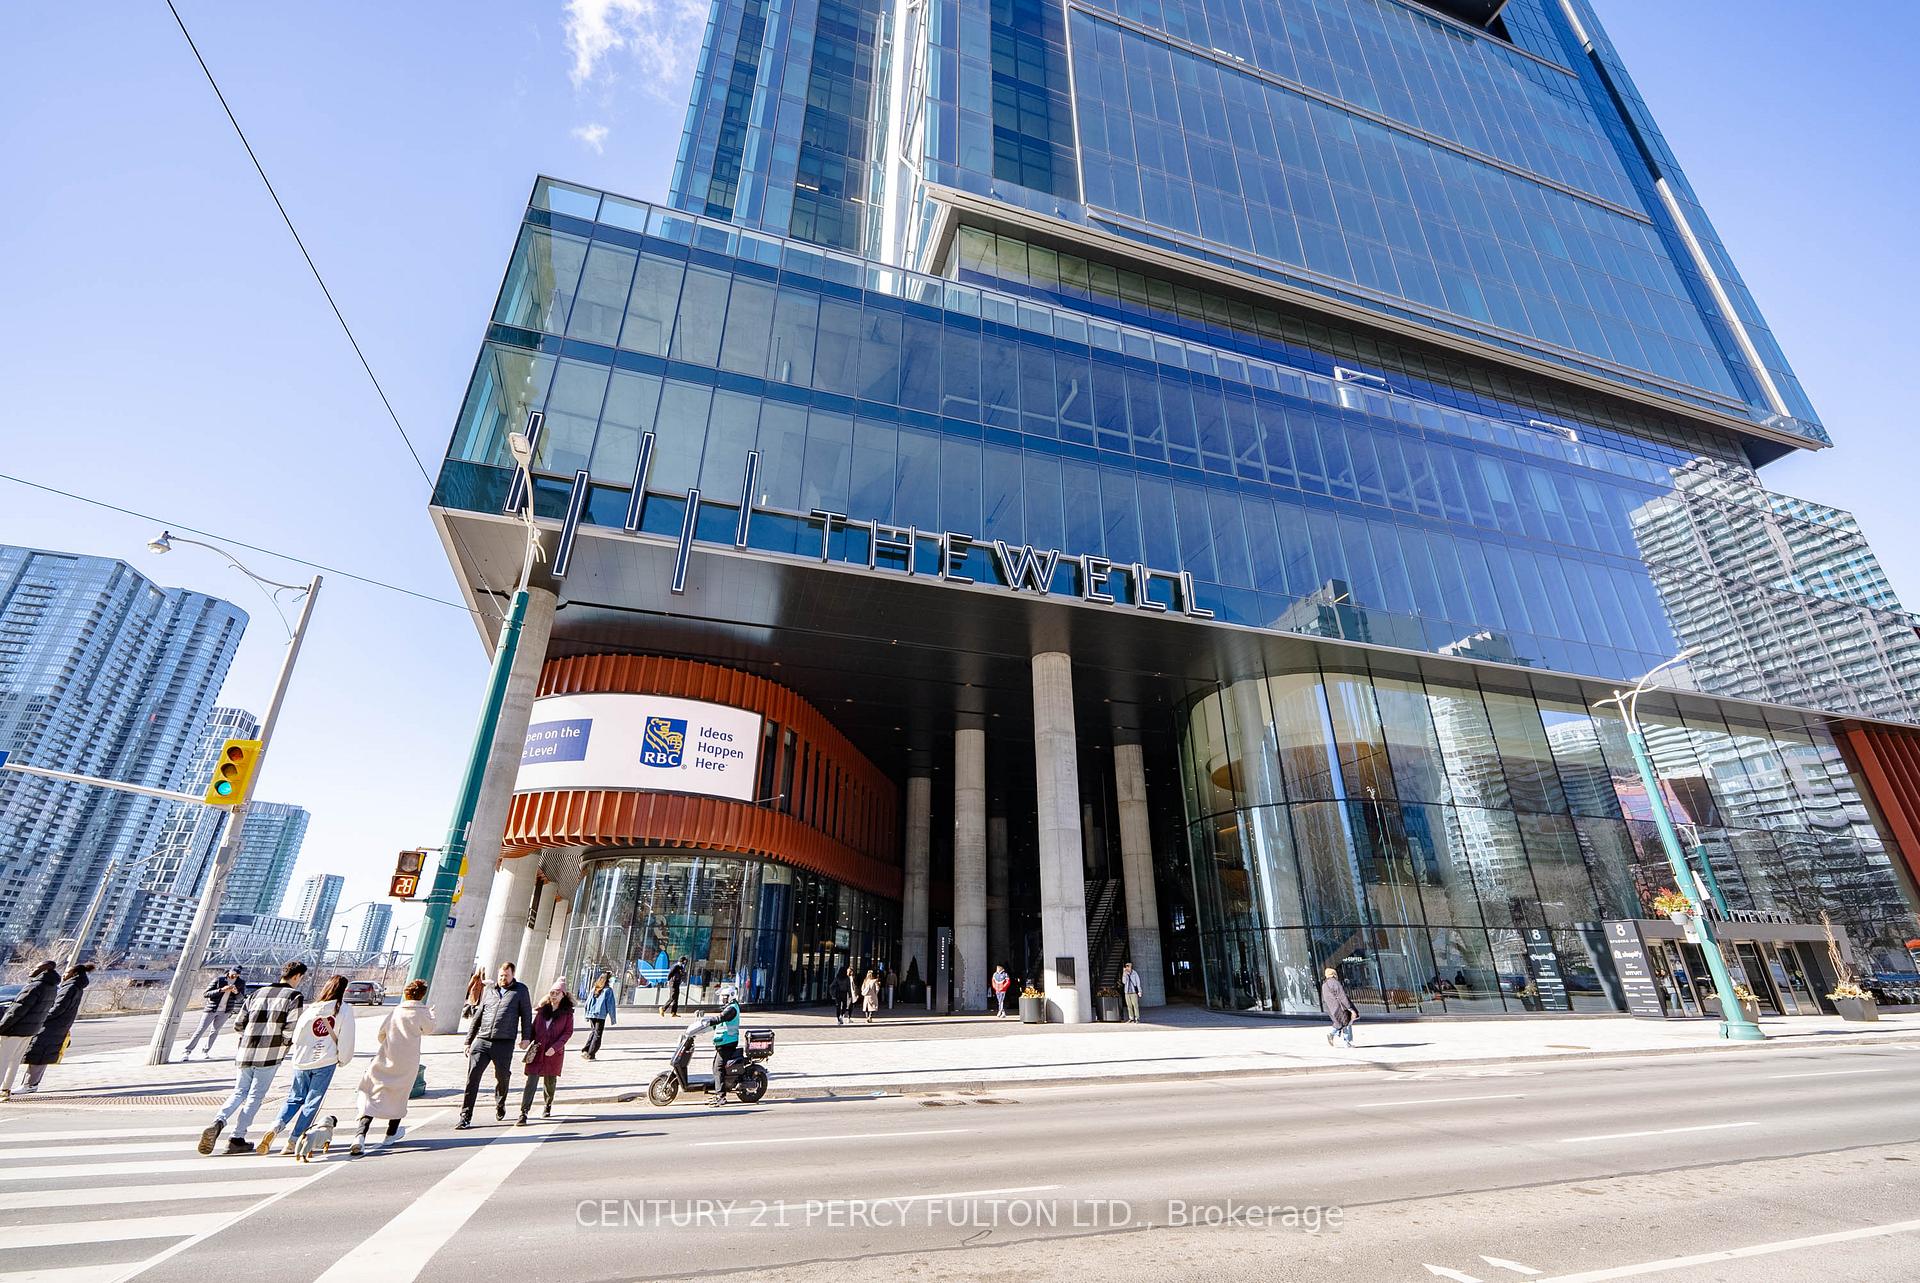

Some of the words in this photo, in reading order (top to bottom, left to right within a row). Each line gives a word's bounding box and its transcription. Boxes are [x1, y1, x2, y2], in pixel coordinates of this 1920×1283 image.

[810, 508, 975, 585] THE
[994, 538, 1215, 618] WELL
[524, 732, 543, 746] pen
[544, 730, 558, 739] on
[560, 726, 581, 738] the
[700, 727, 734, 742] Ideas
[529, 743, 557, 757] Level
[697, 742, 744, 759] Happen
[644, 752, 679, 765] RBC
[395, 877, 414, 894] 28
[1615, 923, 1626, 937] 8
